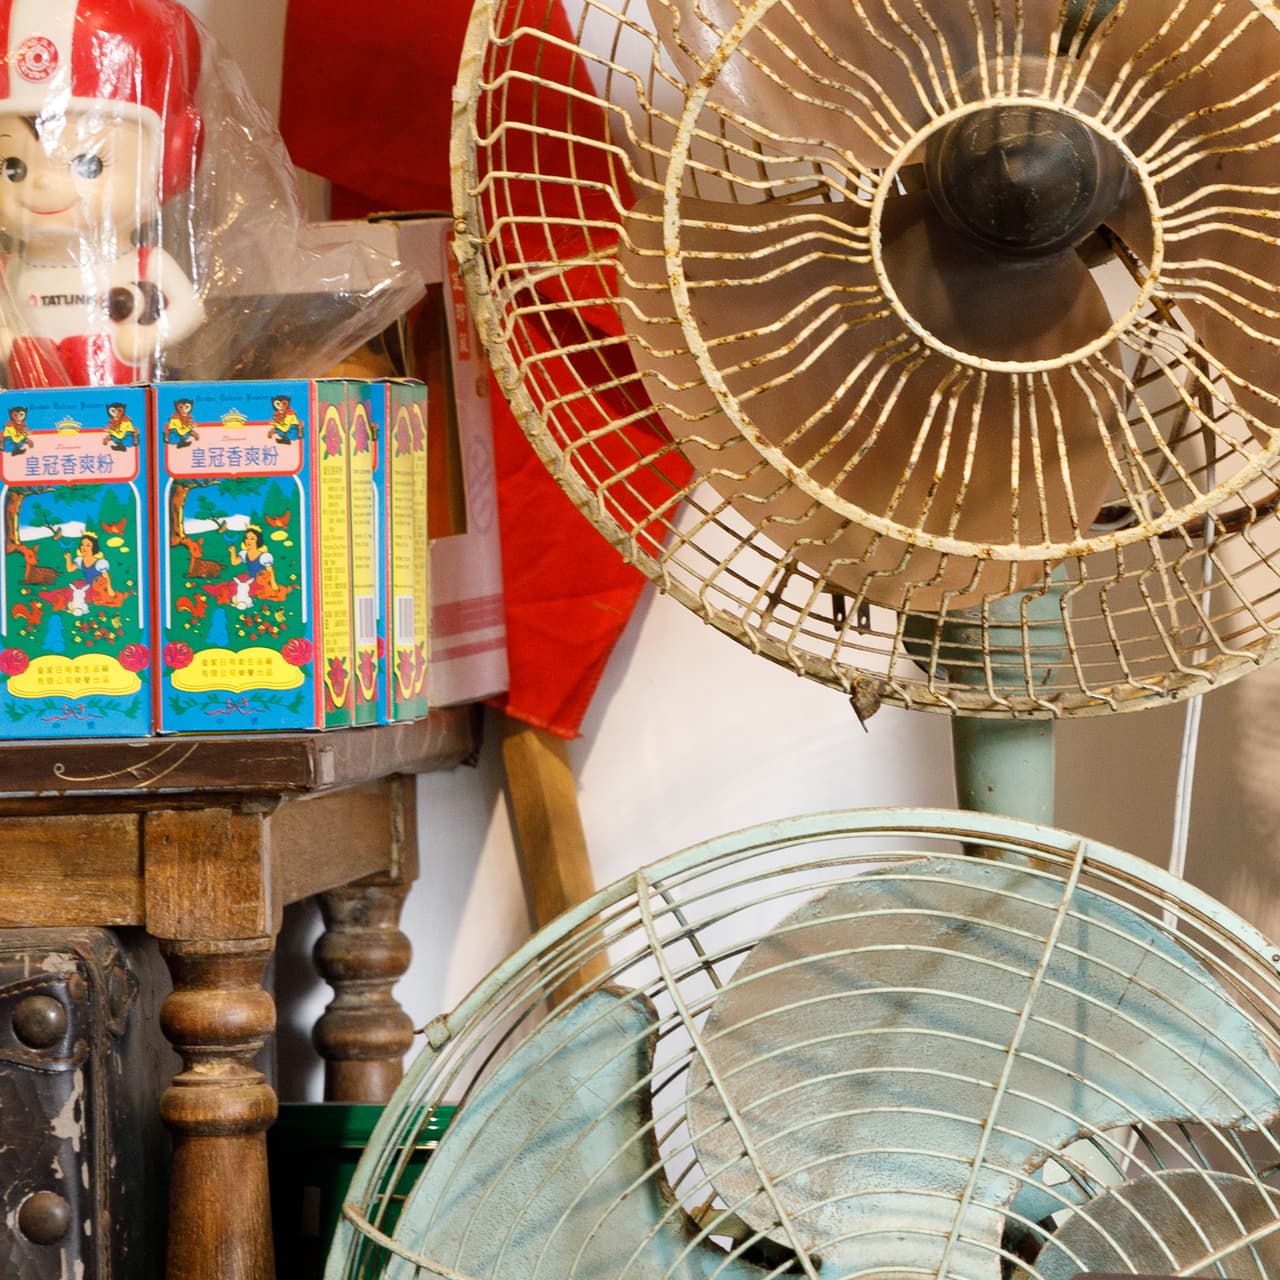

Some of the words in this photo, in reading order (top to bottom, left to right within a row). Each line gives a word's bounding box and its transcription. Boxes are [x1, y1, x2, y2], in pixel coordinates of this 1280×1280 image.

[25, 453, 115, 477] 皇冠香爽粉
[191, 445, 279, 469] 皇冠香爽粉
